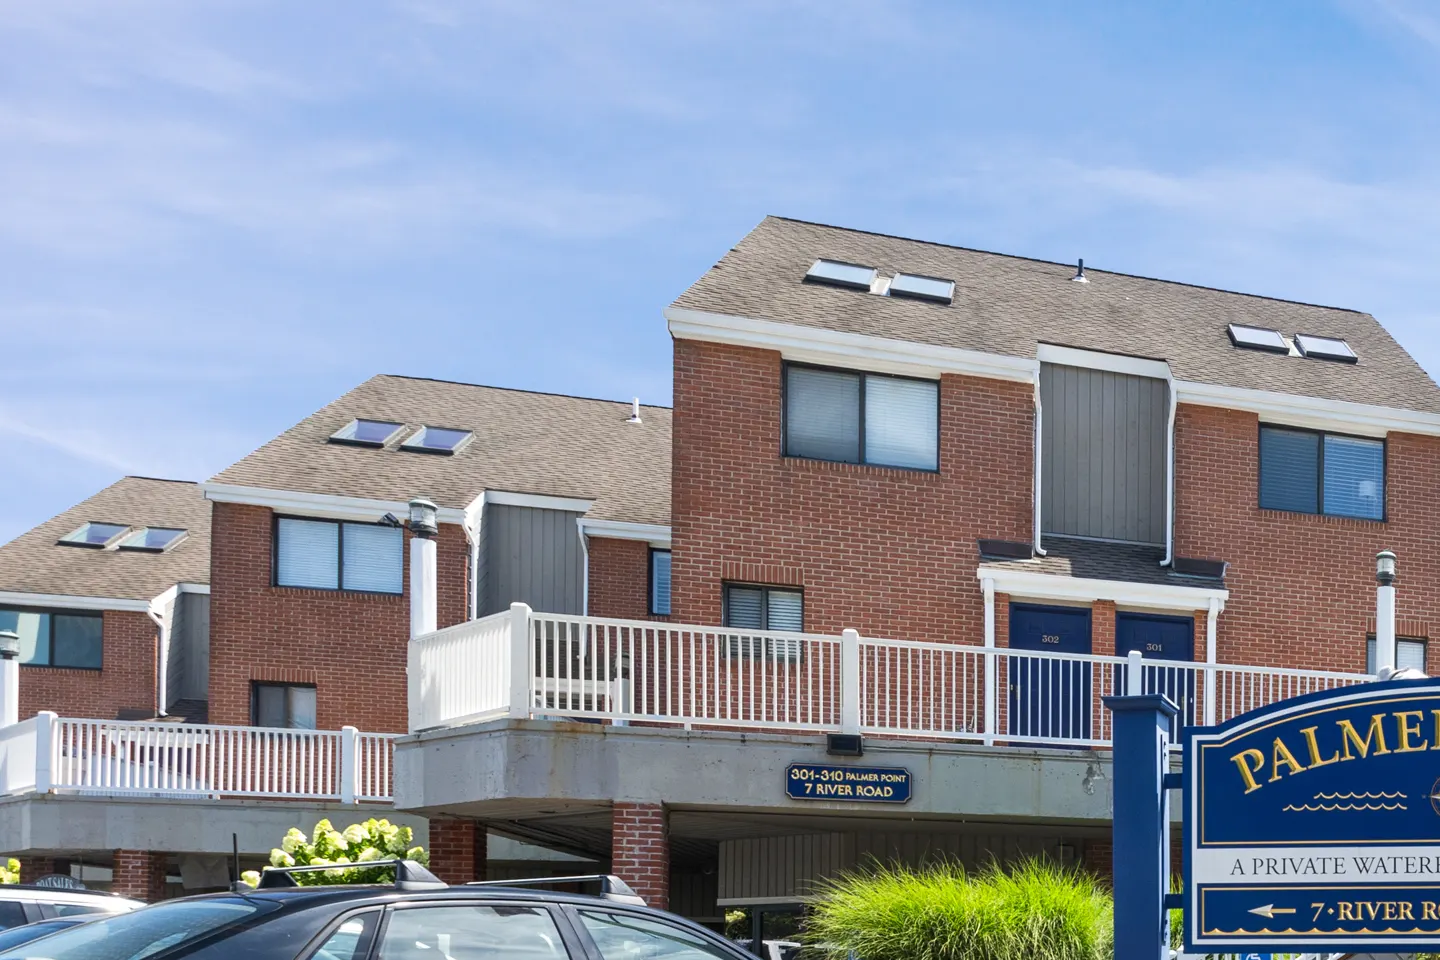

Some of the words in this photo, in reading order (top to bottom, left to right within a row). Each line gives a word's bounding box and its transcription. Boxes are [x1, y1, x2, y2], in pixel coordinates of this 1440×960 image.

[1042, 635, 1059, 643] 302
[1146, 643, 1162, 651] 301
[791, 768, 843, 782] 301-310
[845, 773, 879, 782] PALMER
[881, 775, 906, 783] POINT
[804, 783, 813, 794] 7
[816, 784, 853, 796] RIVER
[856, 786, 893, 797] ROAD
[1230, 858, 1246, 875] A
[1252, 857, 1346, 875] PRIVATE
